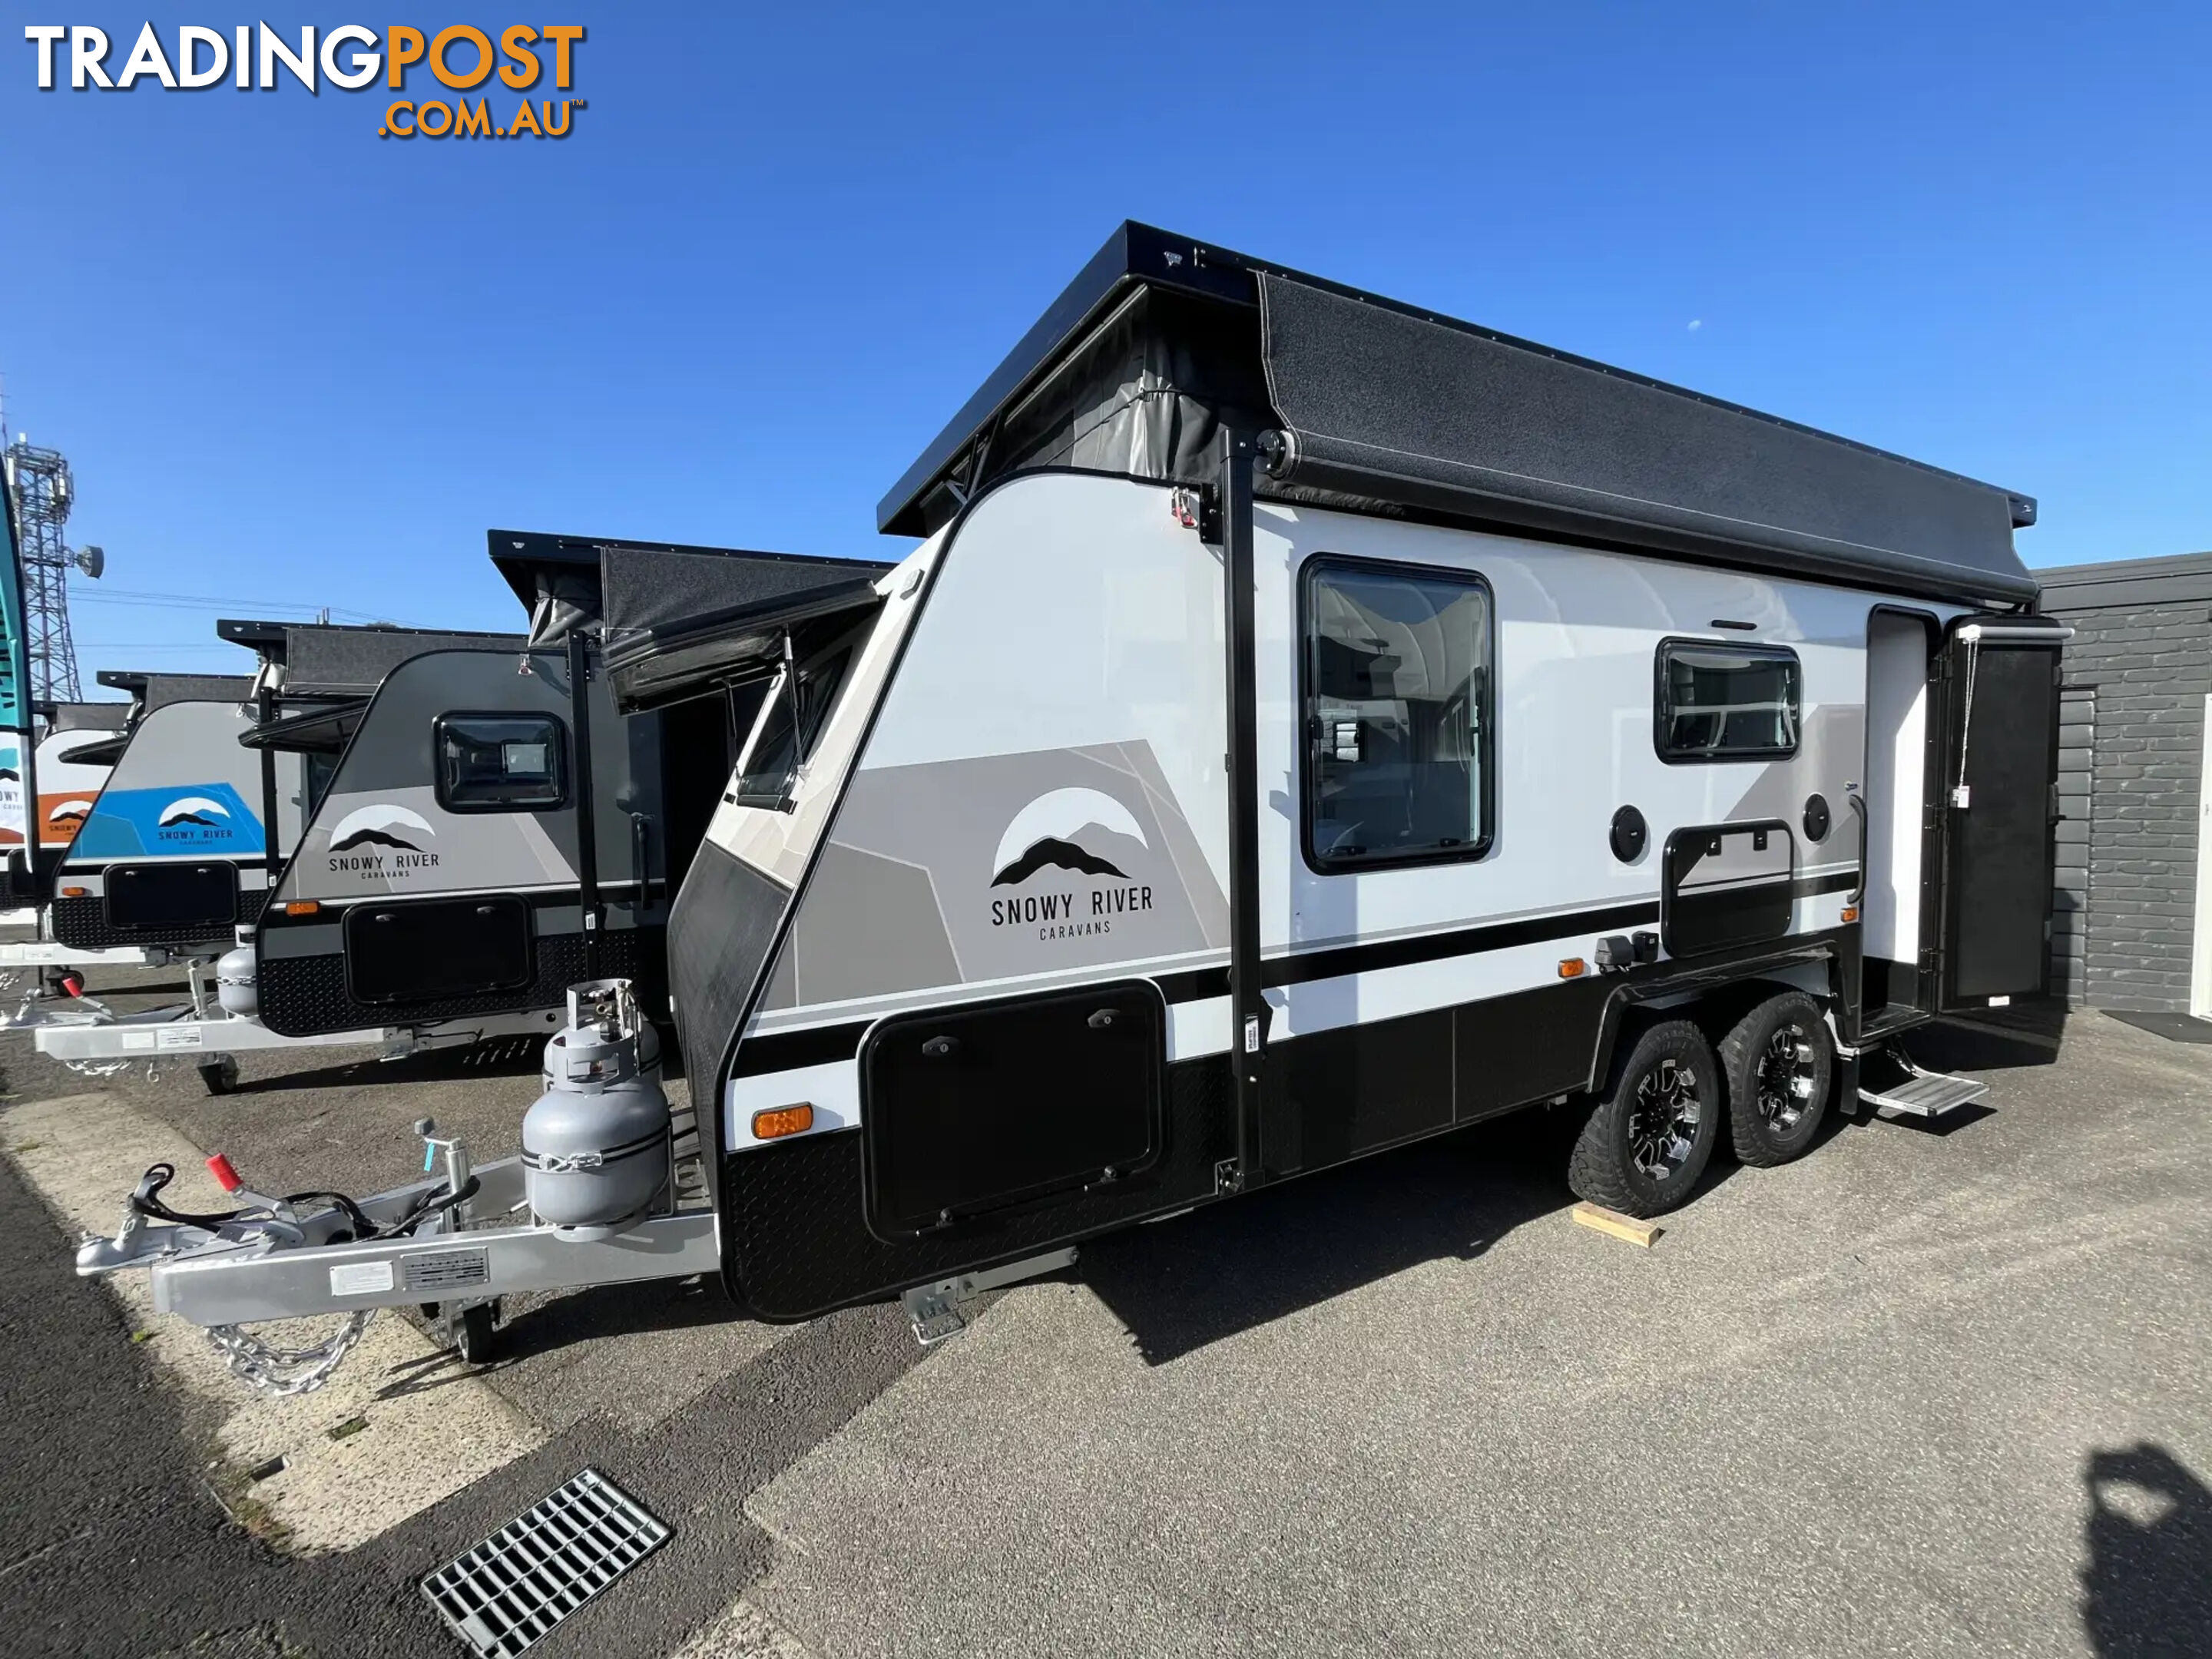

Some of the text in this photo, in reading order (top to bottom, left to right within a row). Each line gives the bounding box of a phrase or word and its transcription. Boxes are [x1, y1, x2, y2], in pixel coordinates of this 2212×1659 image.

[158, 830, 233, 840] SNOWY RIVER
[329, 853, 439, 871] SNOWY RIVER
[361, 870, 410, 879] CARAVANS
[991, 886, 1153, 926] SNOWY RIVER
[1039, 921, 1111, 941] CARAVANS
